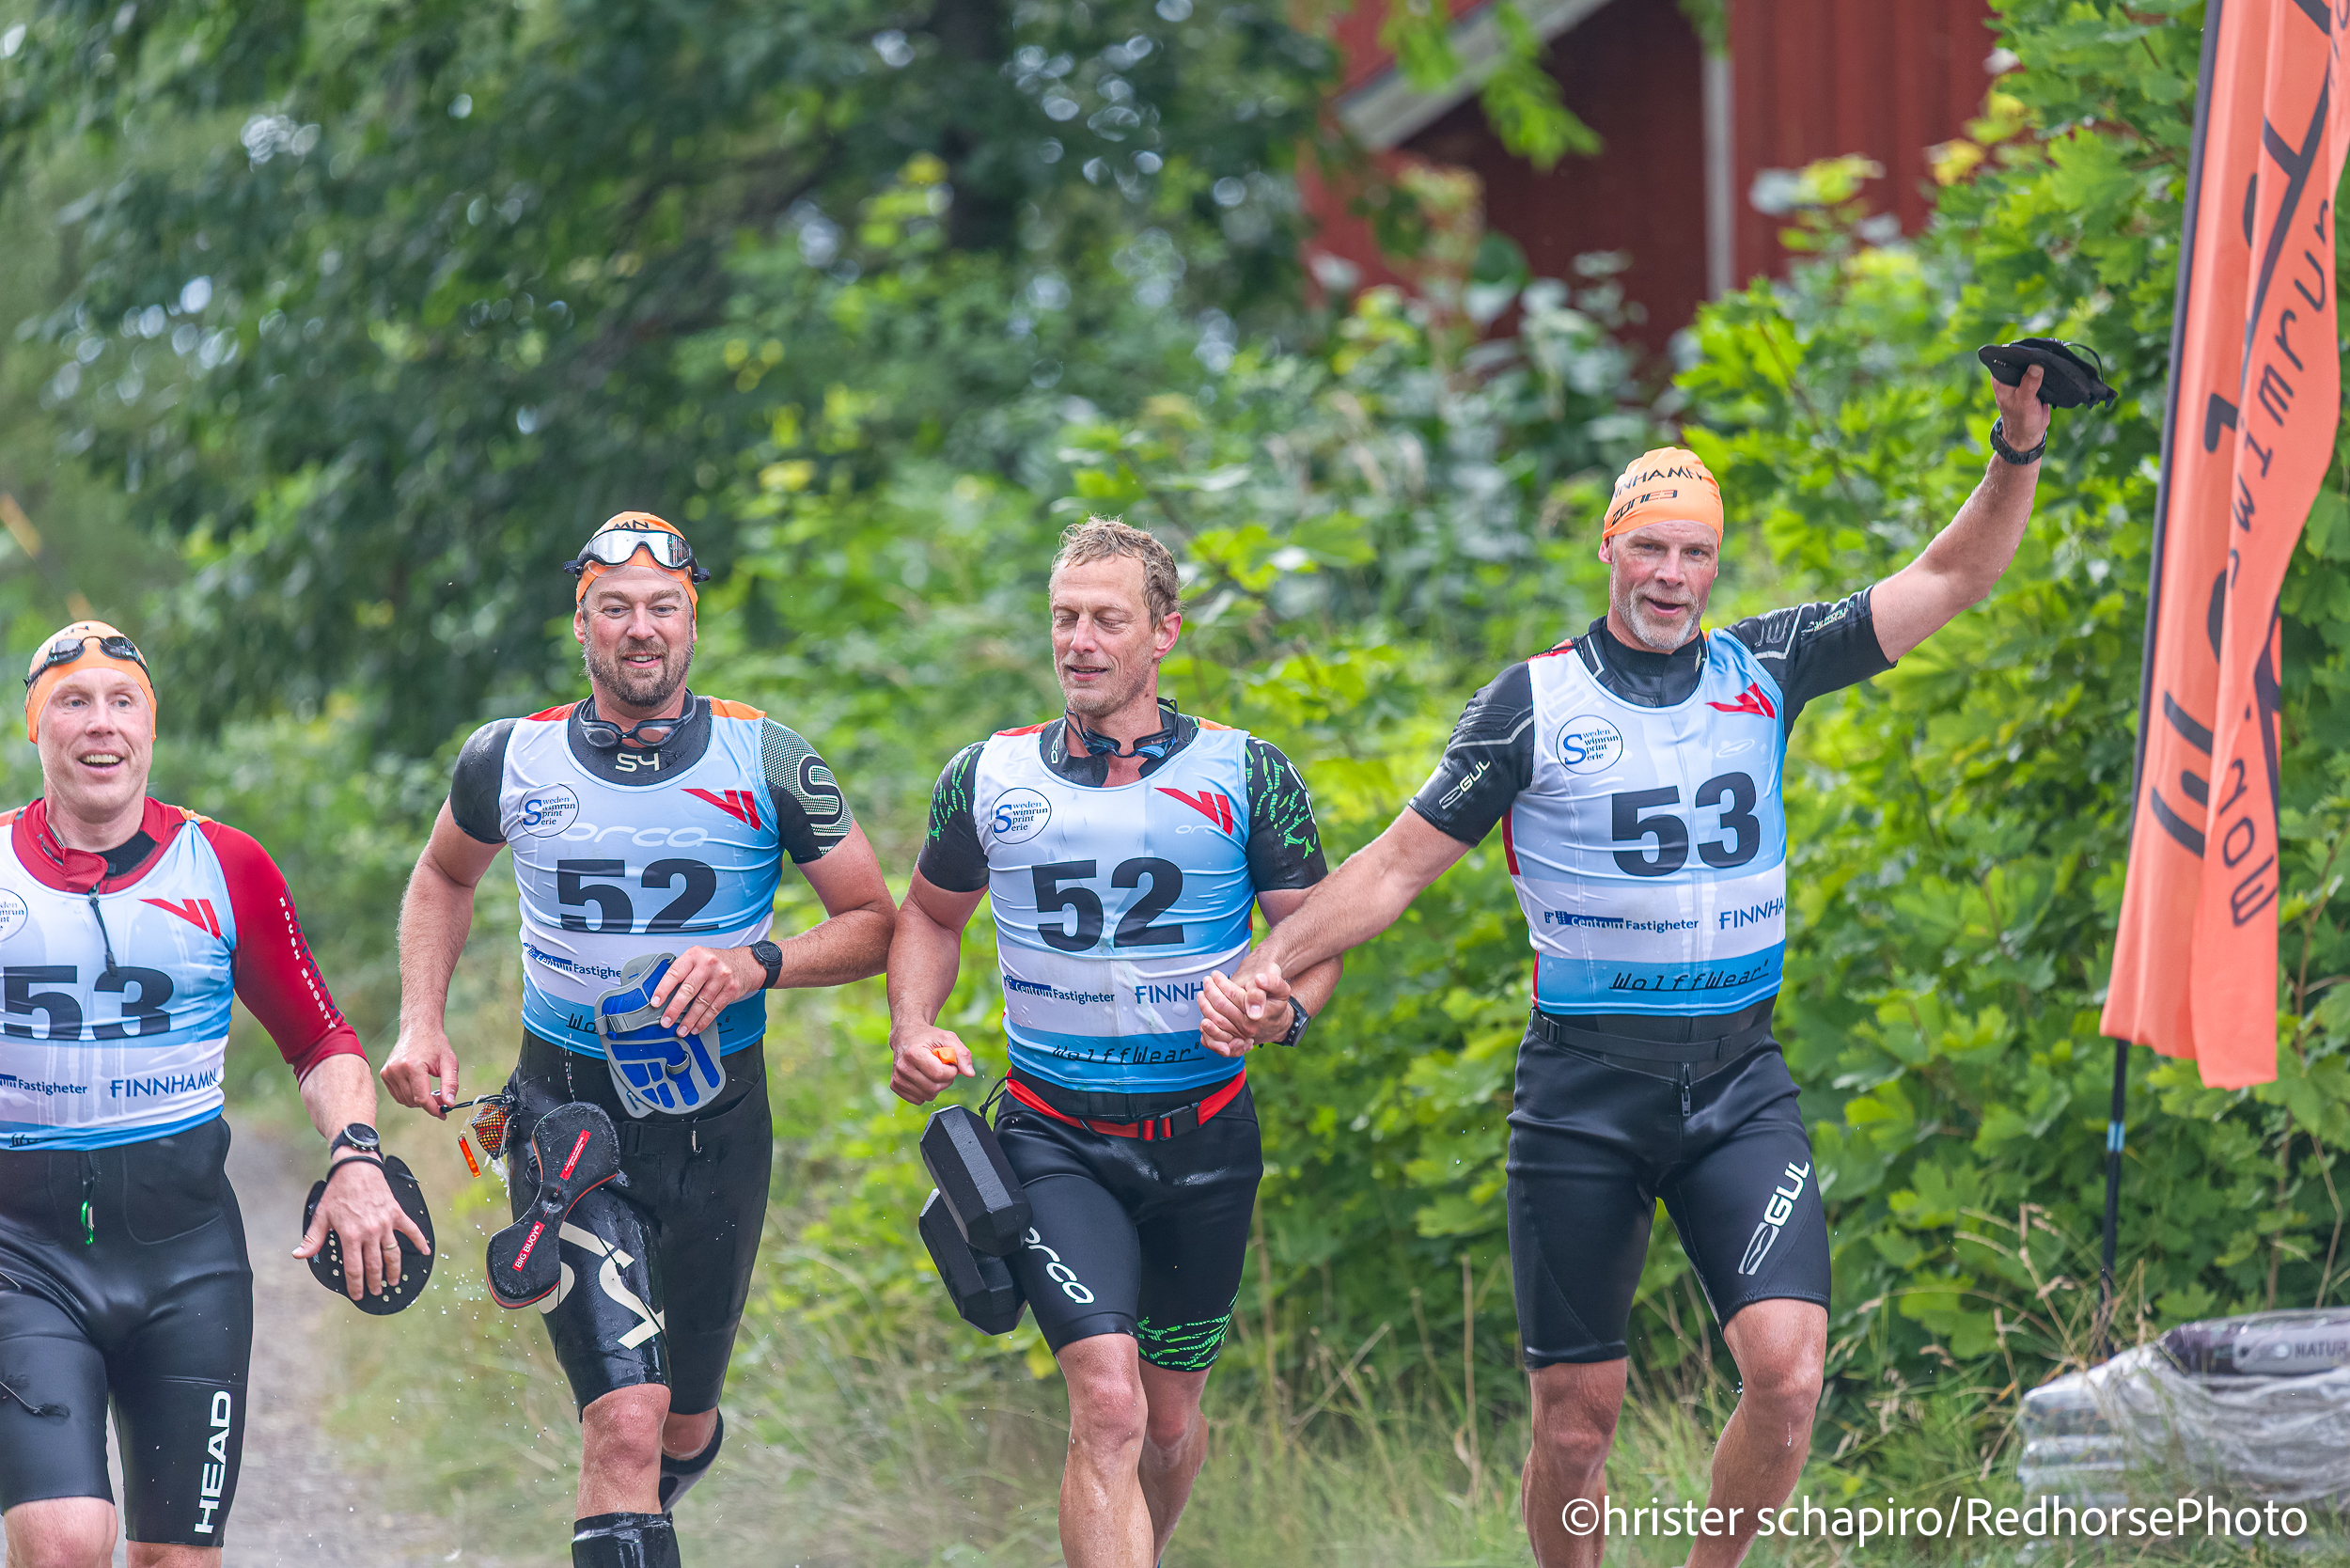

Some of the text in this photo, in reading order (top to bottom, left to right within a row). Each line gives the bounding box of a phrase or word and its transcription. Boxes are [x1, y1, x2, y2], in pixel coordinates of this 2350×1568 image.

[615, 753, 660, 773] S4
[1459, 760, 1491, 792] GUL
[1611, 772, 1761, 877] 53
[557, 857, 719, 933] 52
[1031, 856, 1185, 952] 52
[1571, 916, 1700, 933] Centrum Fastigheter
[1719, 895, 1784, 930] FINNHA
[573, 964, 621, 980] Fastighe
[3, 965, 174, 1041] 53
[301, 967, 337, 1030] SHORTY
[1054, 989, 1115, 1005] Fastigheter
[1135, 981, 1204, 1004] FINNH
[18, 1079, 87, 1095] Fastigheter
[110, 1068, 218, 1098] FINNHAMN
[1763, 1161, 1810, 1227] GUL
[514, 1252, 527, 1269] BIG
[194, 1390, 232, 1534] HEAD
